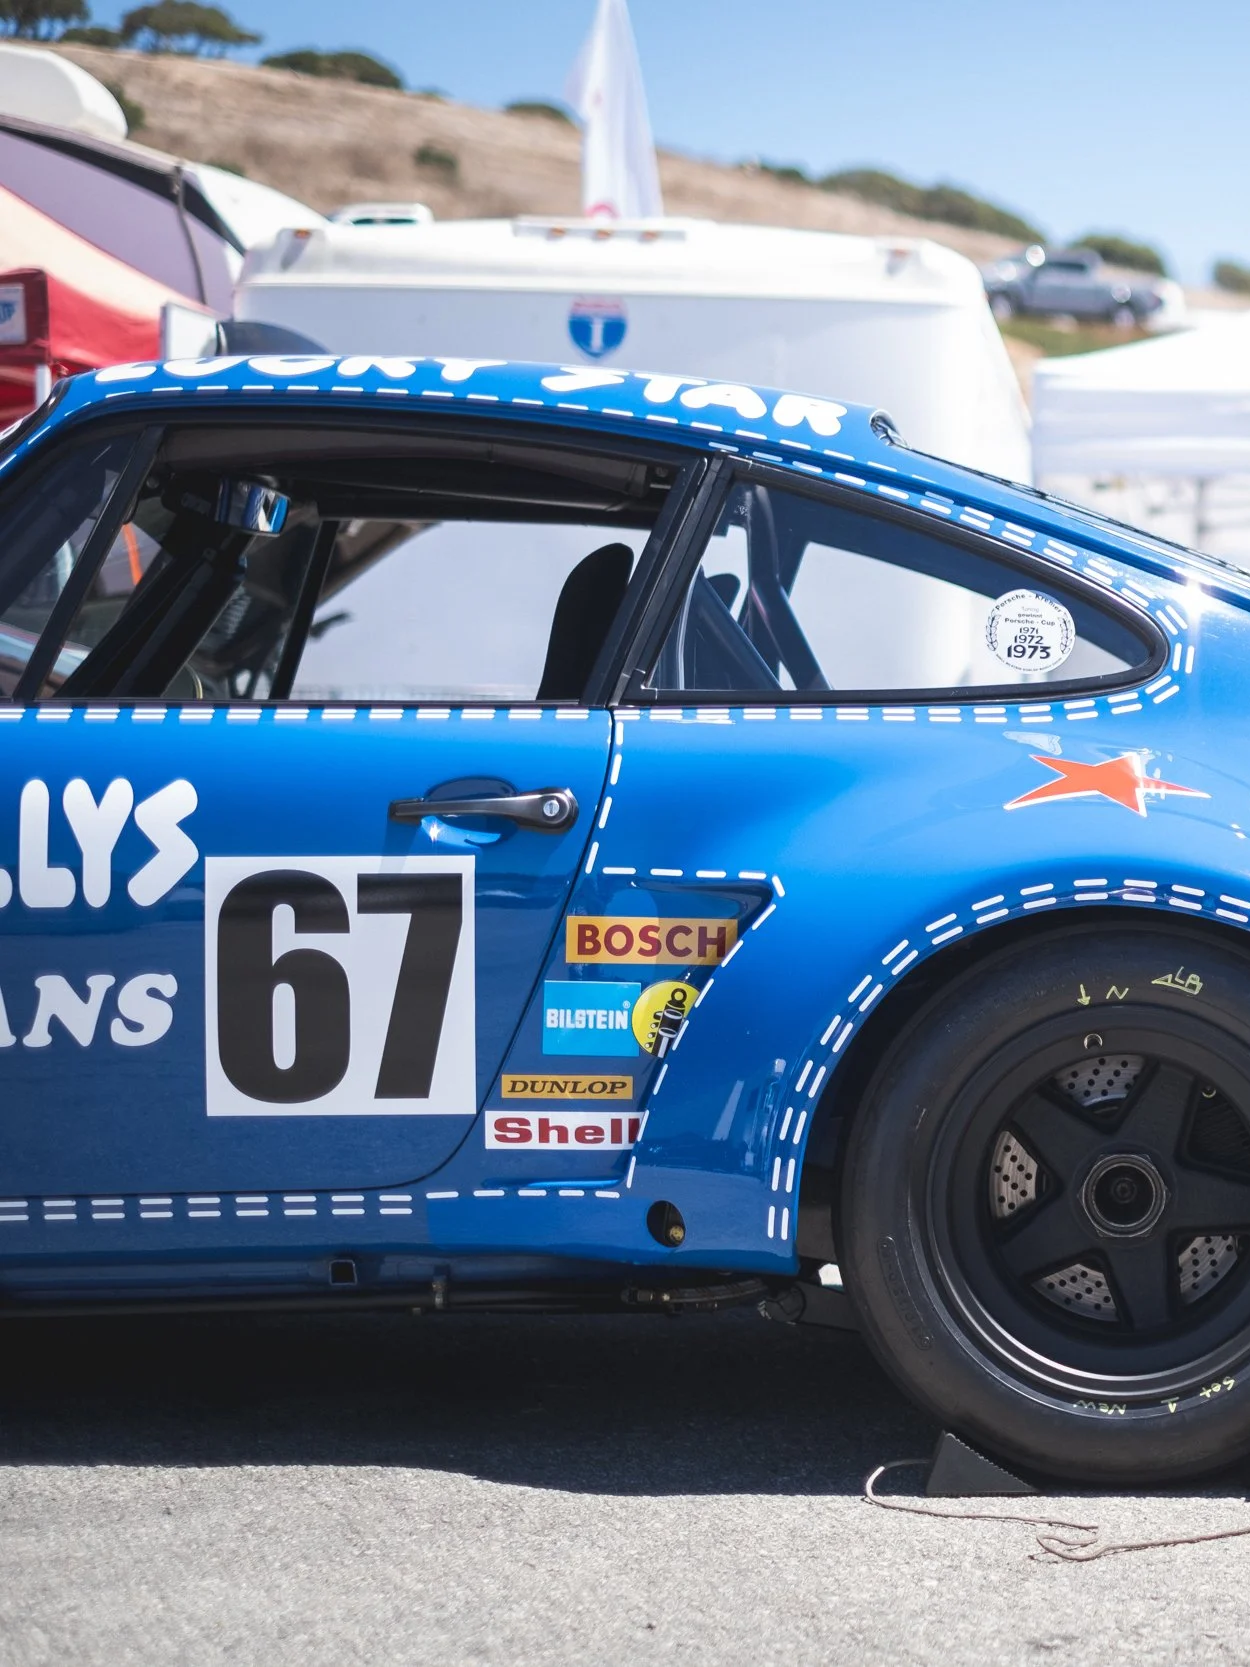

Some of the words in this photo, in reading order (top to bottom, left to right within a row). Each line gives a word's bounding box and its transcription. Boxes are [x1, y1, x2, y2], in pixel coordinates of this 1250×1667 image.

[995, 594, 1025, 610] Porsche
[1007, 645, 1051, 660] 1973
[1014, 635, 1044, 645] 1972
[0, 778, 199, 908] LYS
[577, 924, 727, 958] BOSCH
[217, 869, 463, 1104] 67
[0, 974, 178, 1048] NS
[546, 1008, 629, 1030] BILSTEIN
[507, 1080, 628, 1095] DUNLOP
[494, 1117, 641, 1145] Shell
